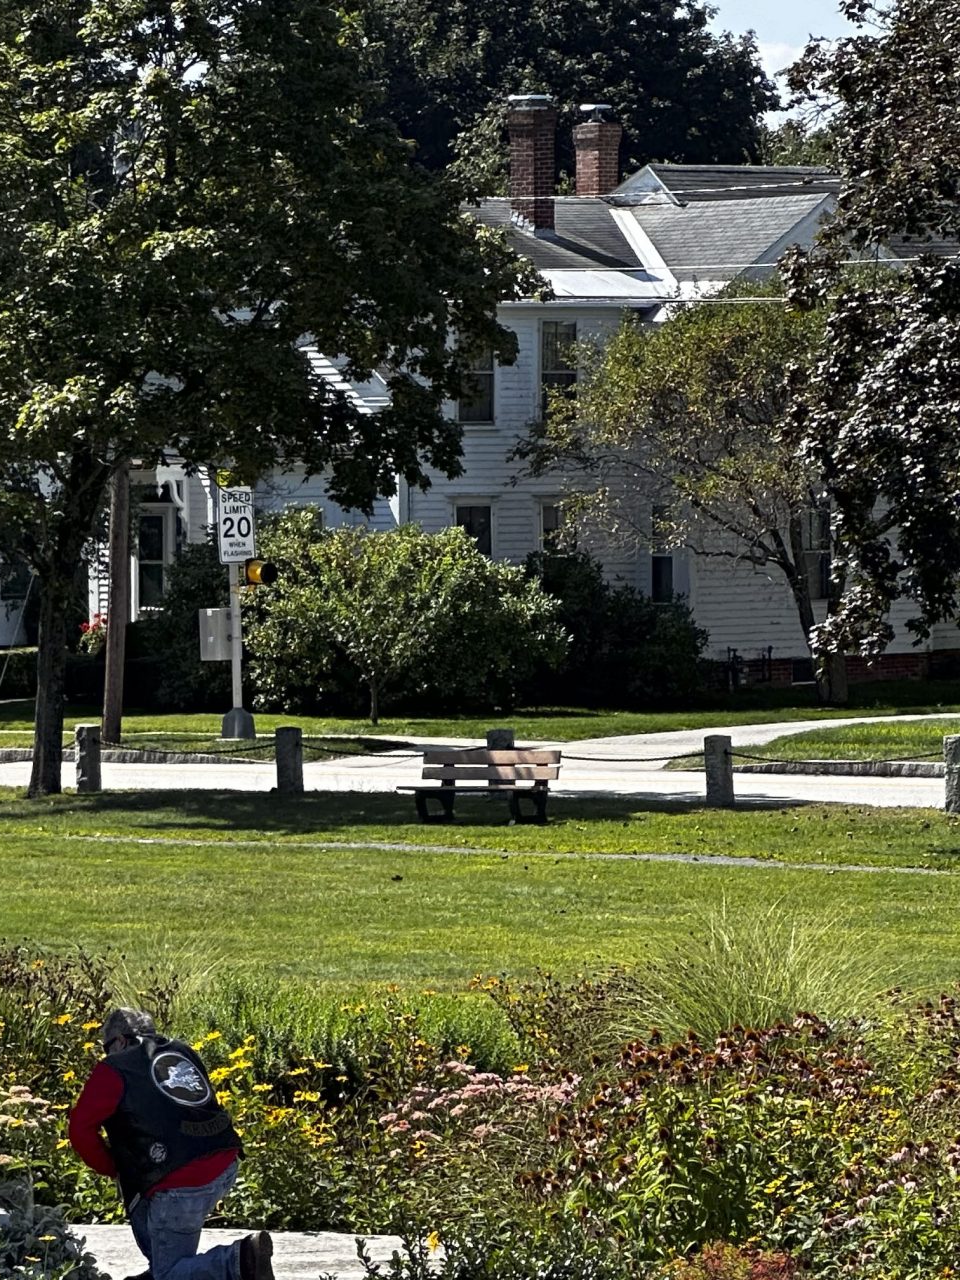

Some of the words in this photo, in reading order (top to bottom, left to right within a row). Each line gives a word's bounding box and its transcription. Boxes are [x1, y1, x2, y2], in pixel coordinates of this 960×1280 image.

[221, 493, 251, 503] SPEED
[224, 505, 247, 515] LIMIT
[222, 516, 251, 538] 20
